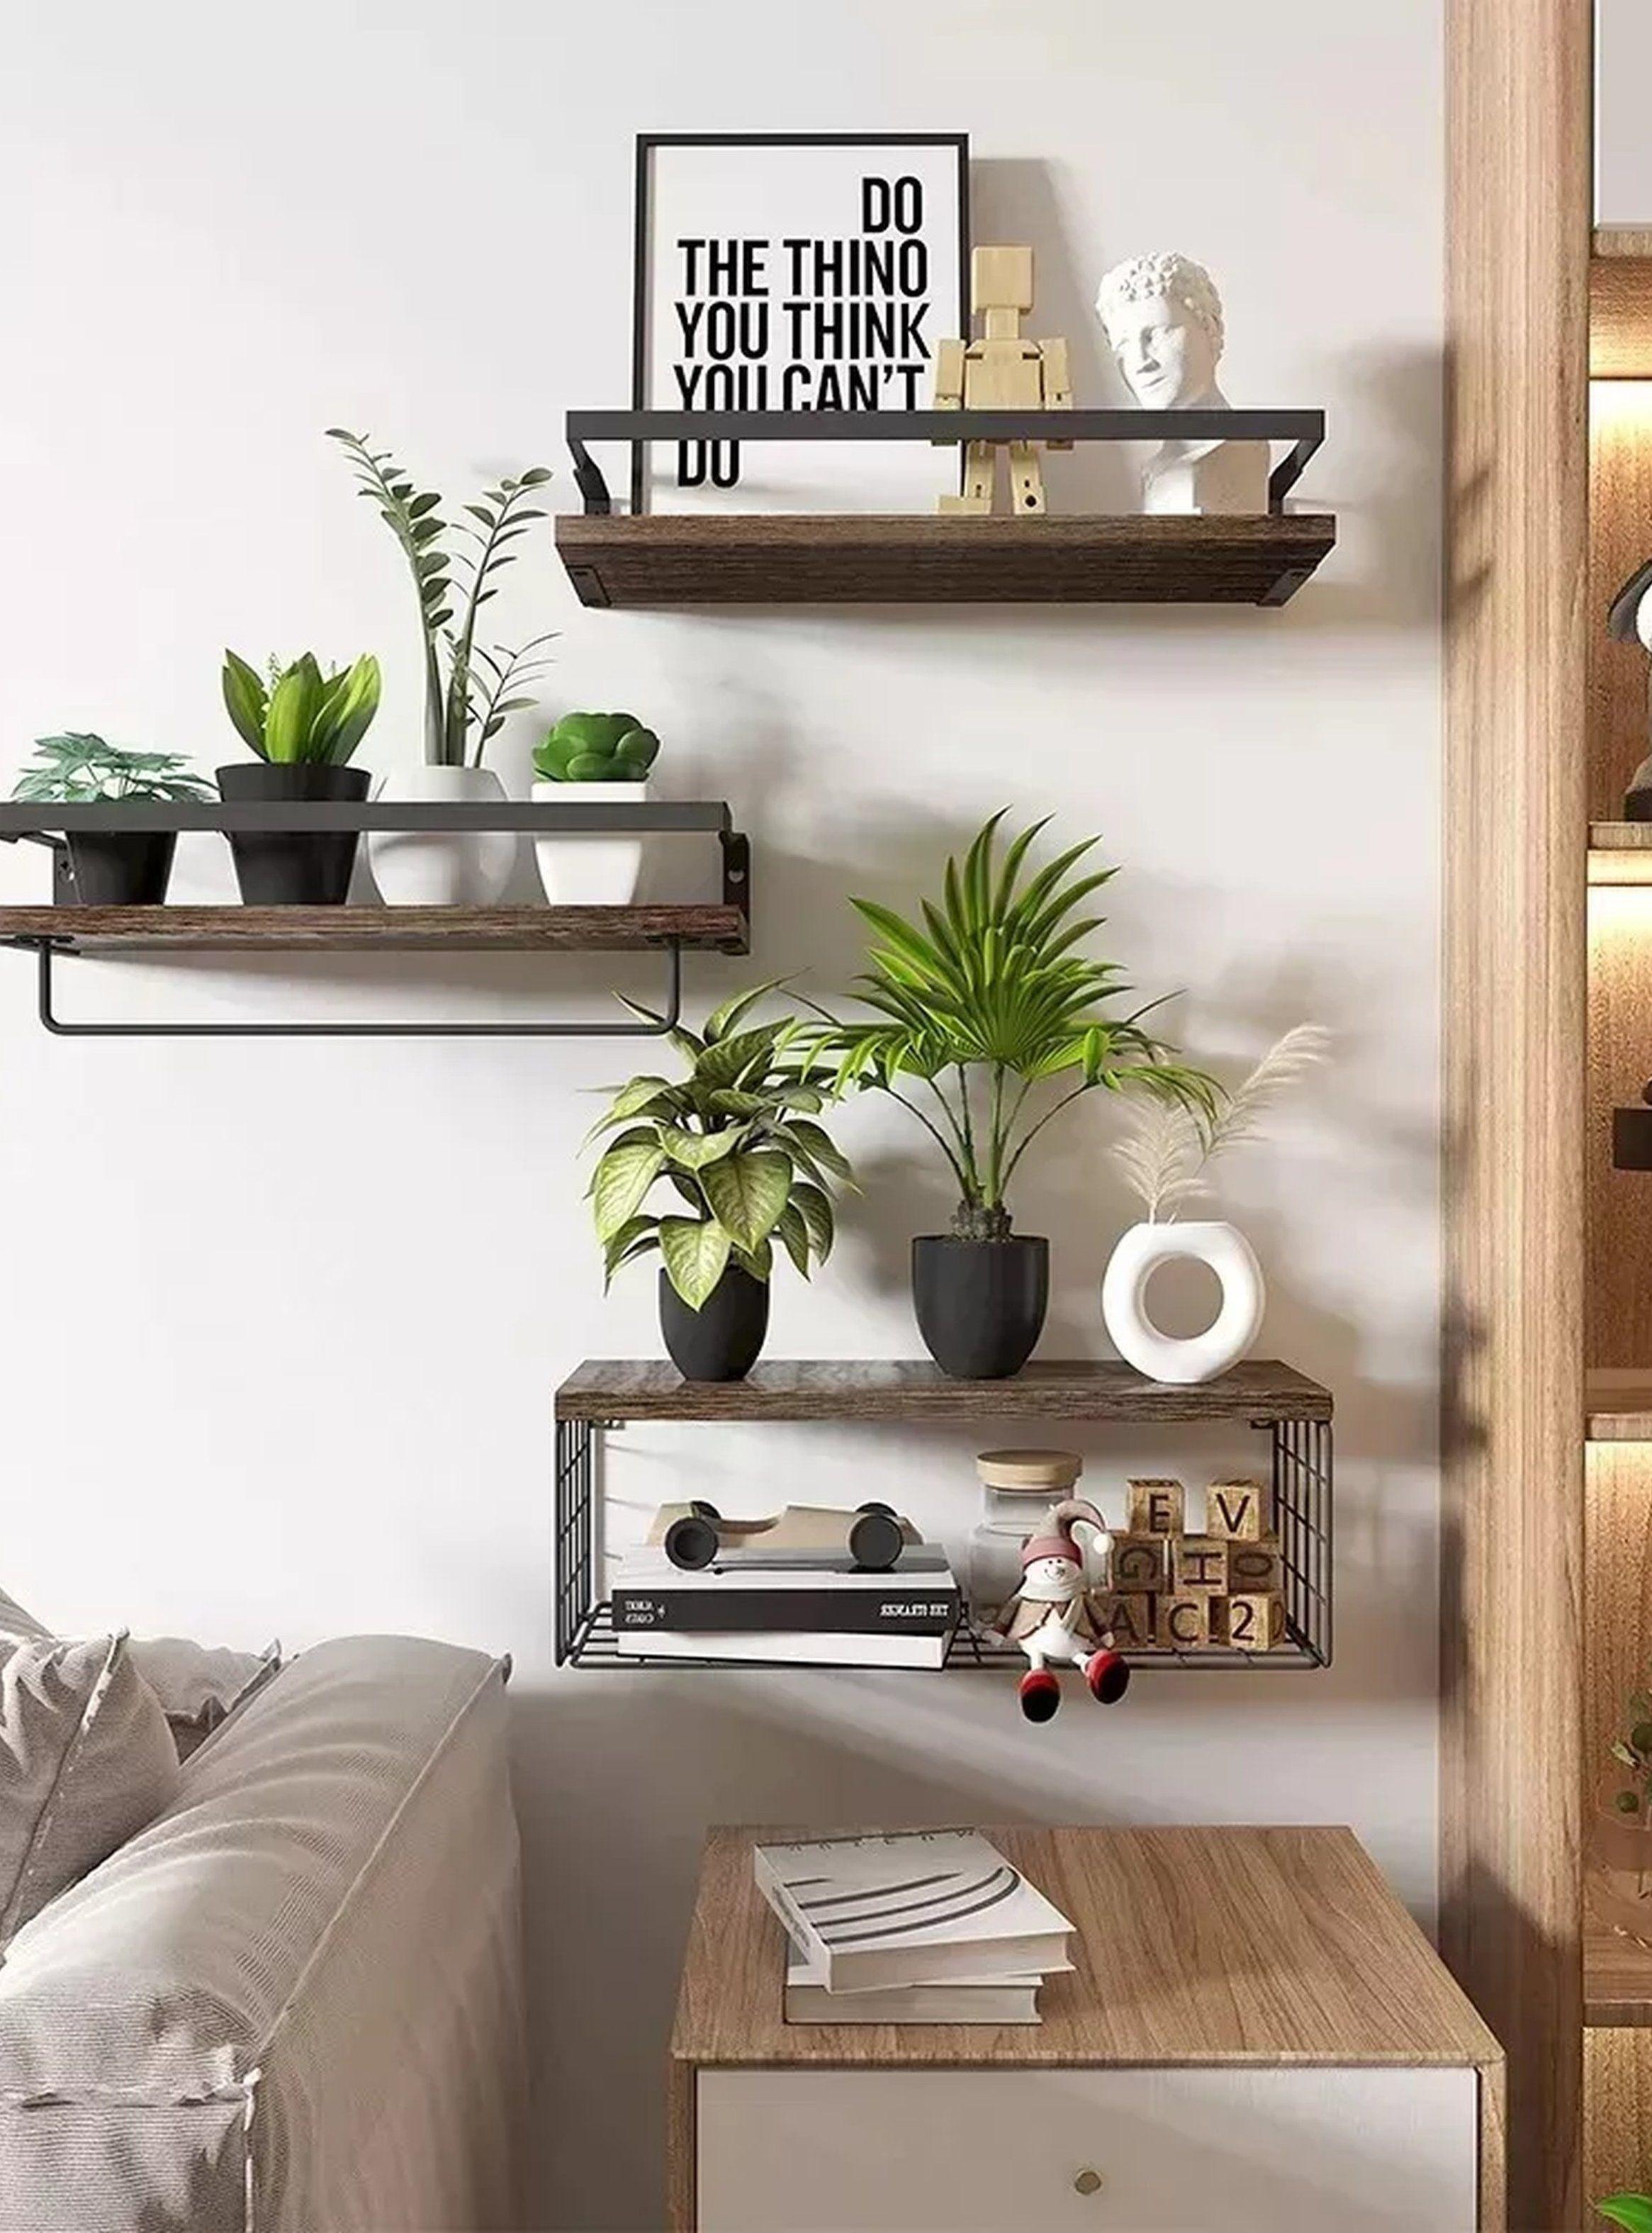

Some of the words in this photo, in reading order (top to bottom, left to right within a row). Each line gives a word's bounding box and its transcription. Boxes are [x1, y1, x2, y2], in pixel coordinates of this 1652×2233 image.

[863, 177, 922, 234] DO
[678, 240, 768, 296] THE
[675, 302, 768, 360] YOU
[783, 303, 931, 359] THINK
[674, 364, 766, 409] YOU
[783, 364, 924, 409] CAN'T
[1150, 1494, 1169, 1533] E
[1216, 1493, 1250, 1532] V
[1231, 1601, 1254, 1642] 2
